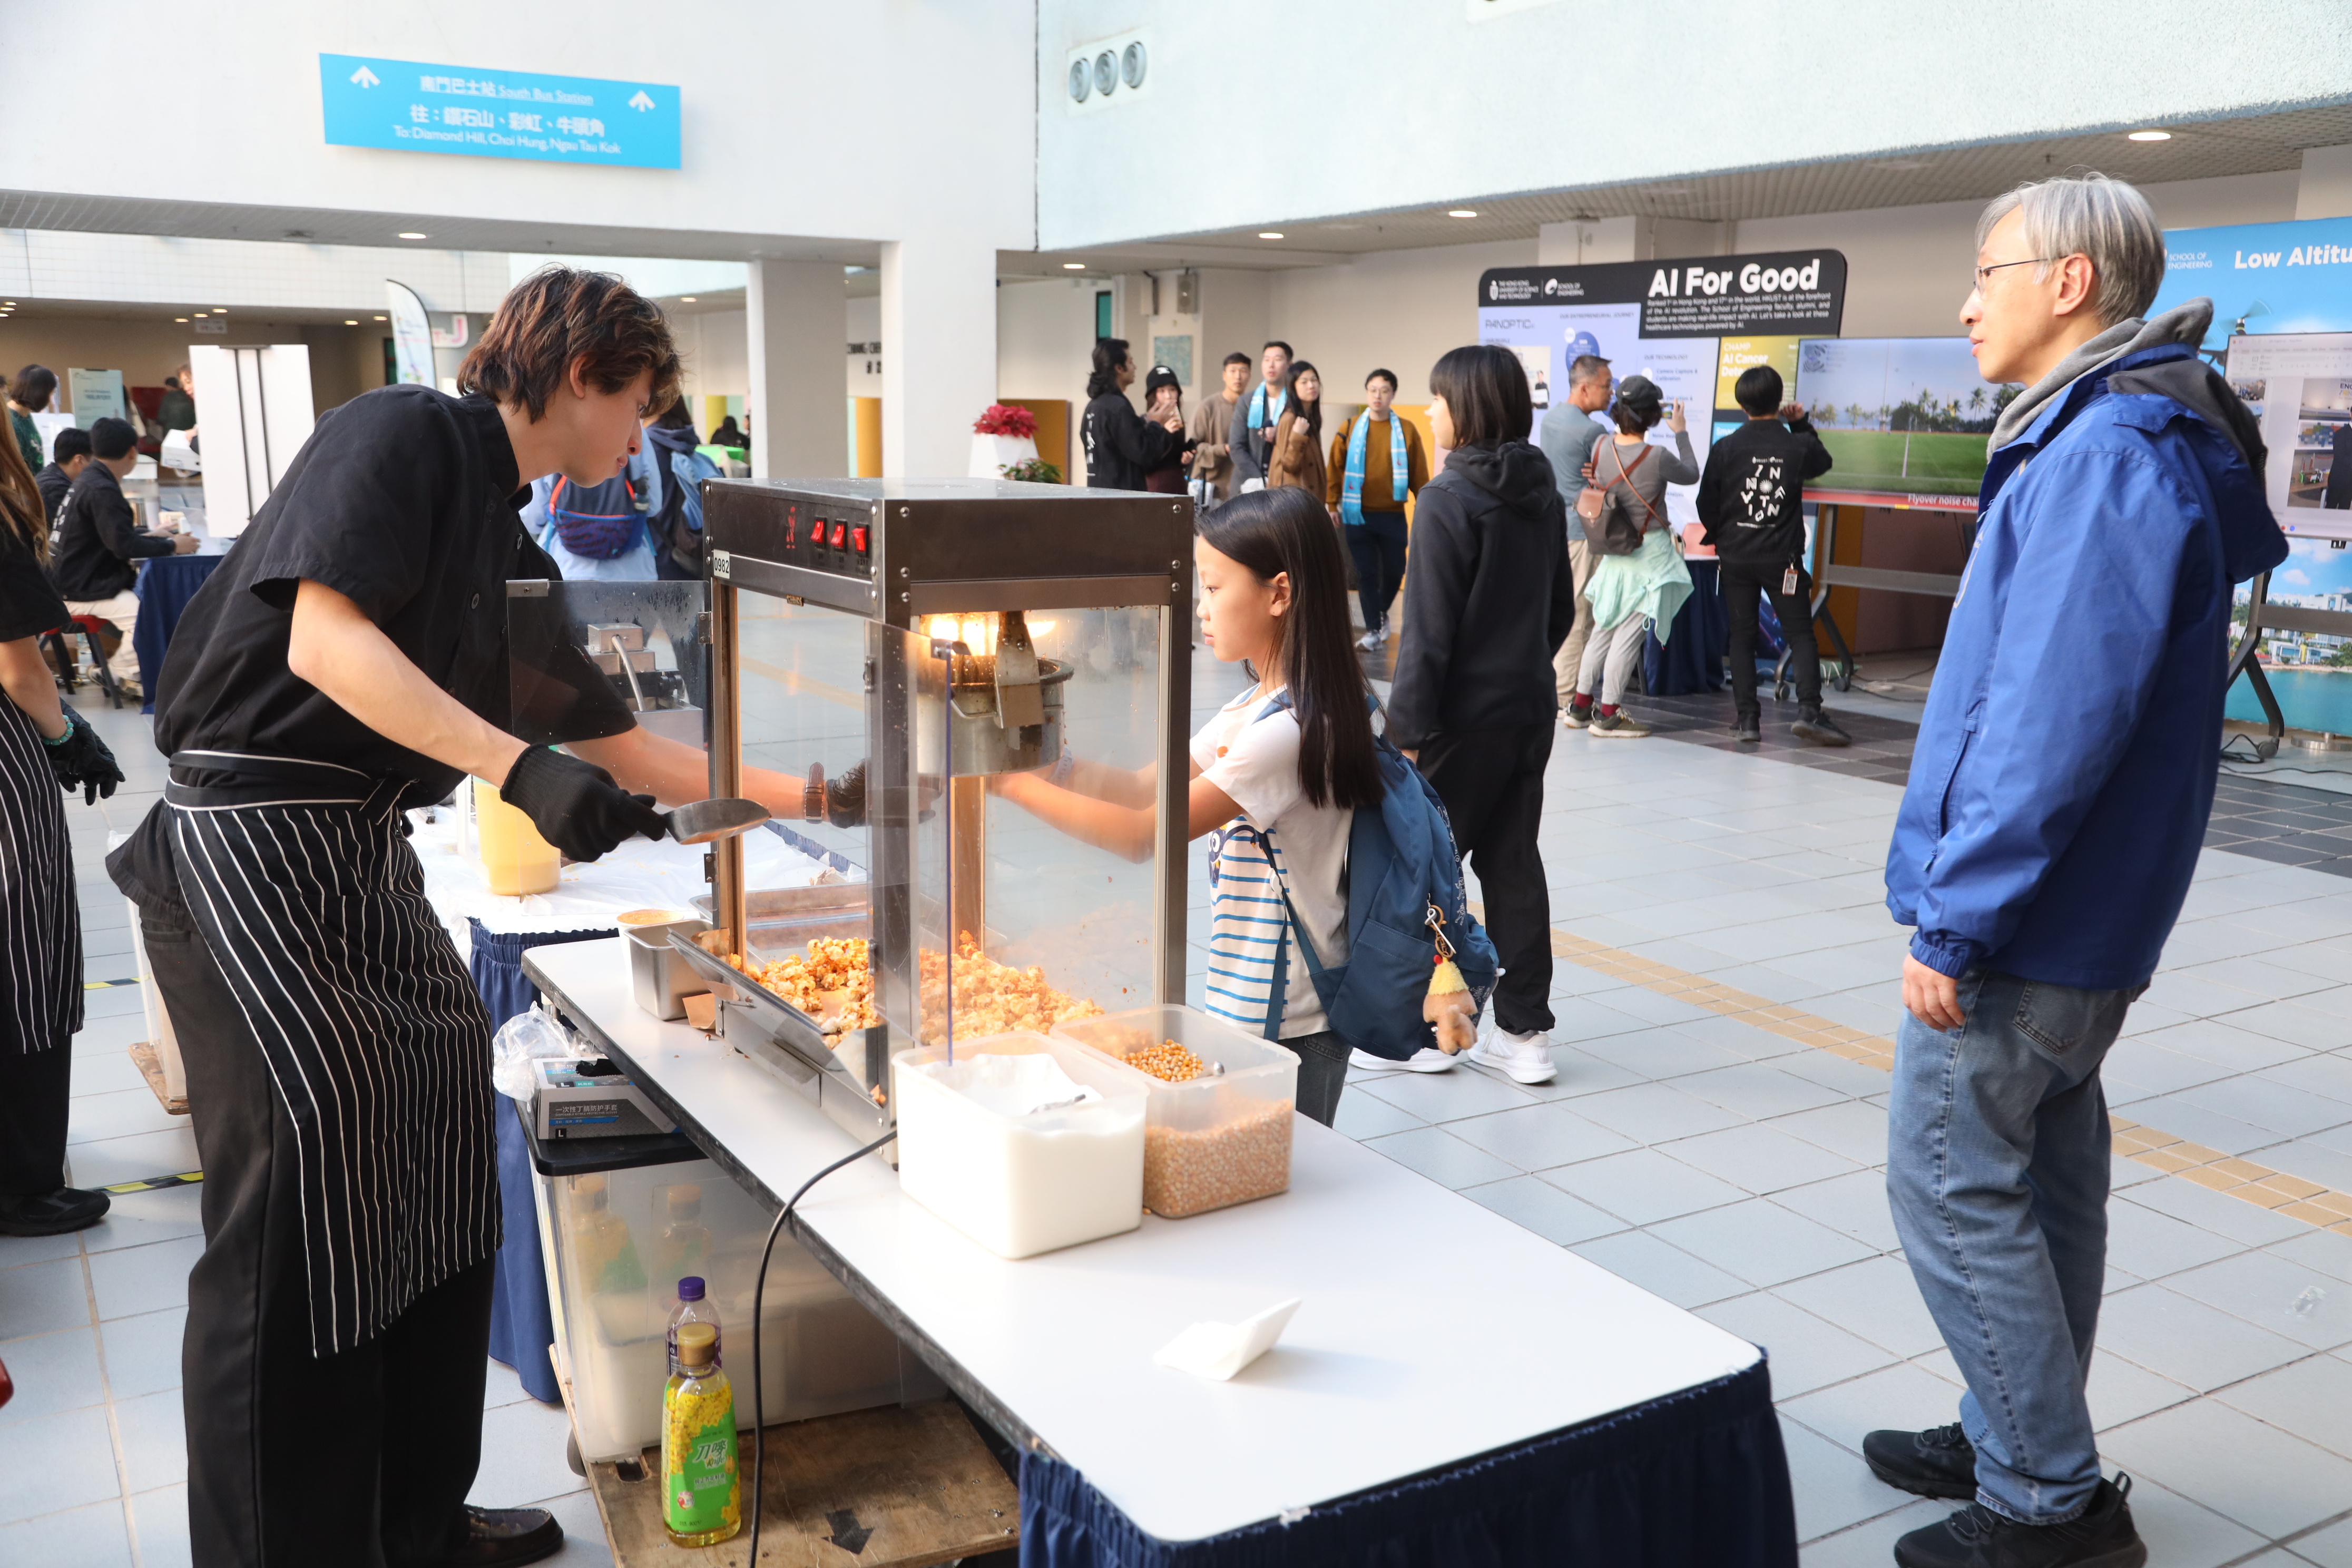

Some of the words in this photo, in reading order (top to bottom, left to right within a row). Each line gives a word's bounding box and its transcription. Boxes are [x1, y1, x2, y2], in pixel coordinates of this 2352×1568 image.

[420, 75, 496, 96] 南門巴士站
[498, 85, 531, 99] South
[533, 87, 554, 100] Bus
[555, 90, 594, 104] Station
[393, 125, 411, 138] To:
[411, 126, 464, 142] Diamond
[488, 132, 515, 146] Choi
[550, 137, 579, 153] Ngau
[579, 139, 597, 152] Tau
[599, 141, 621, 154] Kok
[2169, 252, 2195, 261] SCHOOL
[2235, 250, 2281, 269] Low
[2168, 260, 2213, 270] ENGINEERING
[1648, 268, 1678, 298] AI
[1685, 266, 1733, 296] For
[1739, 259, 1820, 294] Good
[1678, 298, 1692, 307] Hong
[1693, 298, 1707, 306] Kong
[1761, 293, 1781, 302] HKUST
[1795, 292, 1805, 301] the
[1805, 292, 1831, 301] forefront
[1700, 305, 1711, 313] The
[1712, 305, 1731, 313] School
[1739, 303, 1773, 313] Engineering
[1678, 315, 1697, 323] making
[1718, 313, 1737, 321] impact
[1773, 311, 1786, 319] take
[1672, 322, 1704, 331] technologies
[1722, 354, 1734, 364] AI
[1735, 353, 1769, 364] Cancer
[1908, 493, 1937, 505] Flyover
[1939, 495, 1961, 506] noise
[714, 557, 729, 574] 0982
[555, 1104, 618, 1113] 一次性丁腈防护手套
[706, 1457, 726, 1468] Knife
